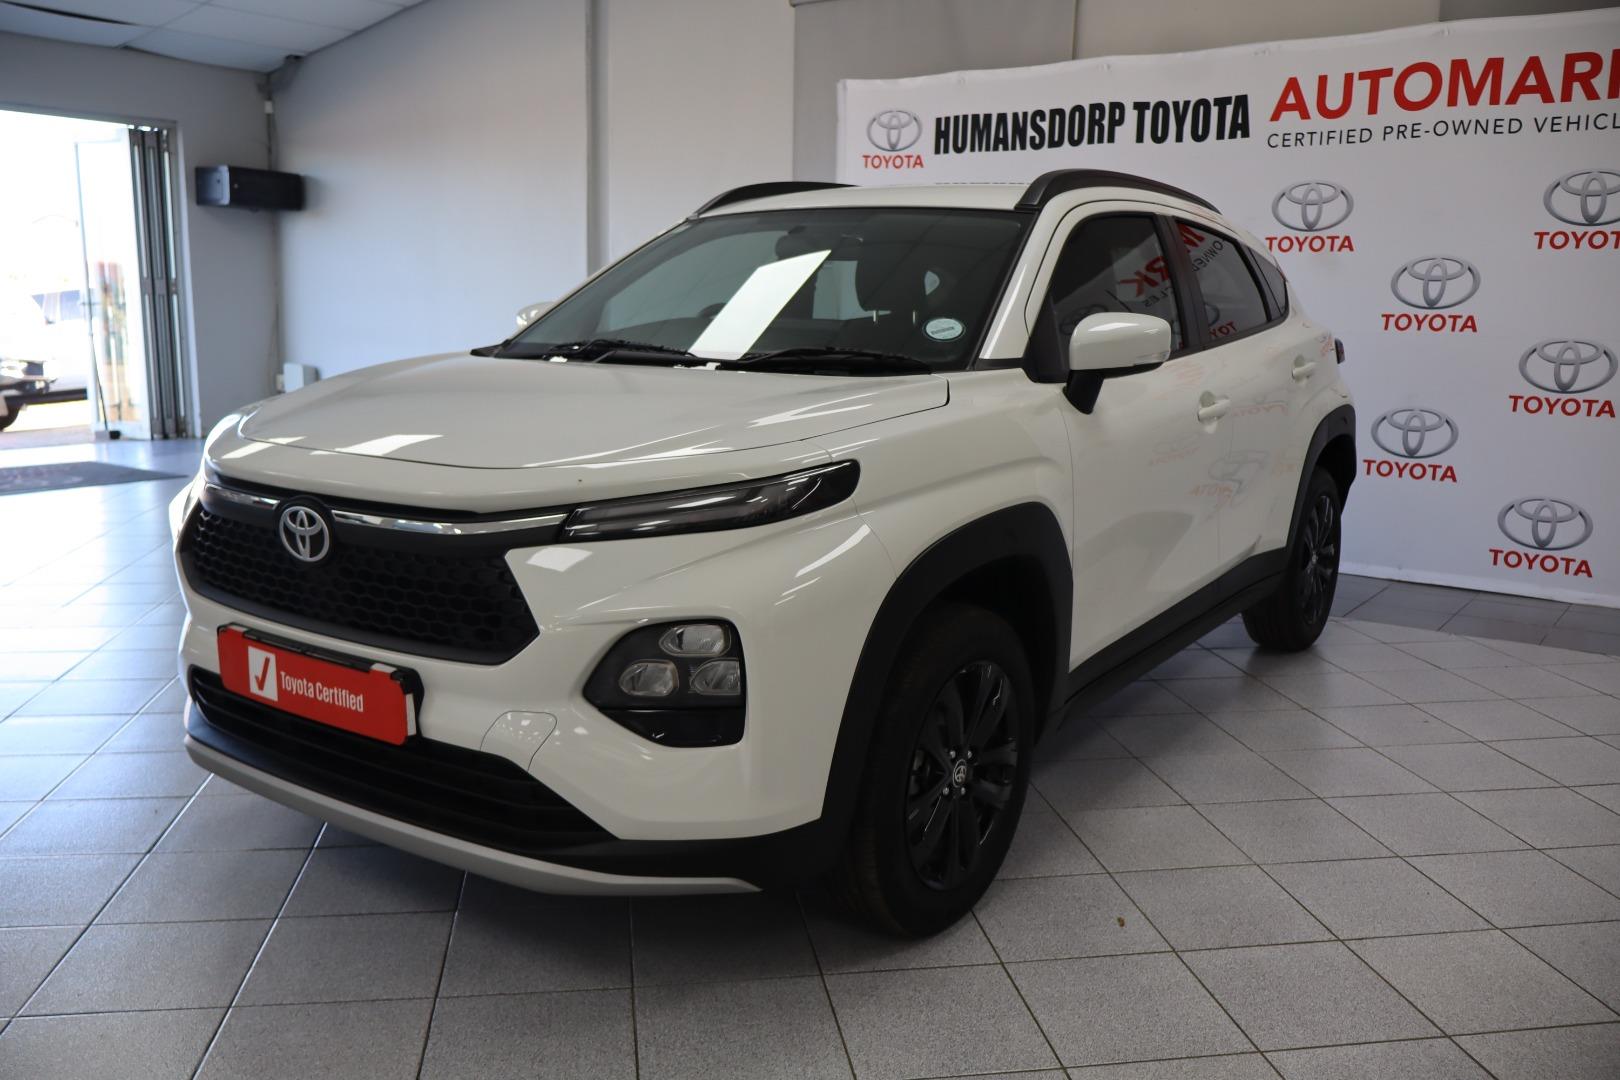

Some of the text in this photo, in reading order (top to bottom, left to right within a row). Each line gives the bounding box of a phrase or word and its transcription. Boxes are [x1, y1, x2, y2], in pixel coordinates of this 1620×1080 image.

[1270, 48, 1620, 122] AUTOMAR
[934, 94, 1250, 155] HUMANSDORP TOYOTA
[1267, 128, 1373, 149] CERTIFIED
[1382, 118, 1523, 142] PRE-OWNED
[863, 154, 924, 169] TOYOTA
[1265, 235, 1354, 253] TOYOTA
[1382, 313, 1477, 333] TOYOTA
[1509, 395, 1615, 418] TOYOTA
[1363, 459, 1457, 483] TOYOTA
[1489, 549, 1593, 577] TOYOTA
[280, 671, 364, 713] Toyota Certified
